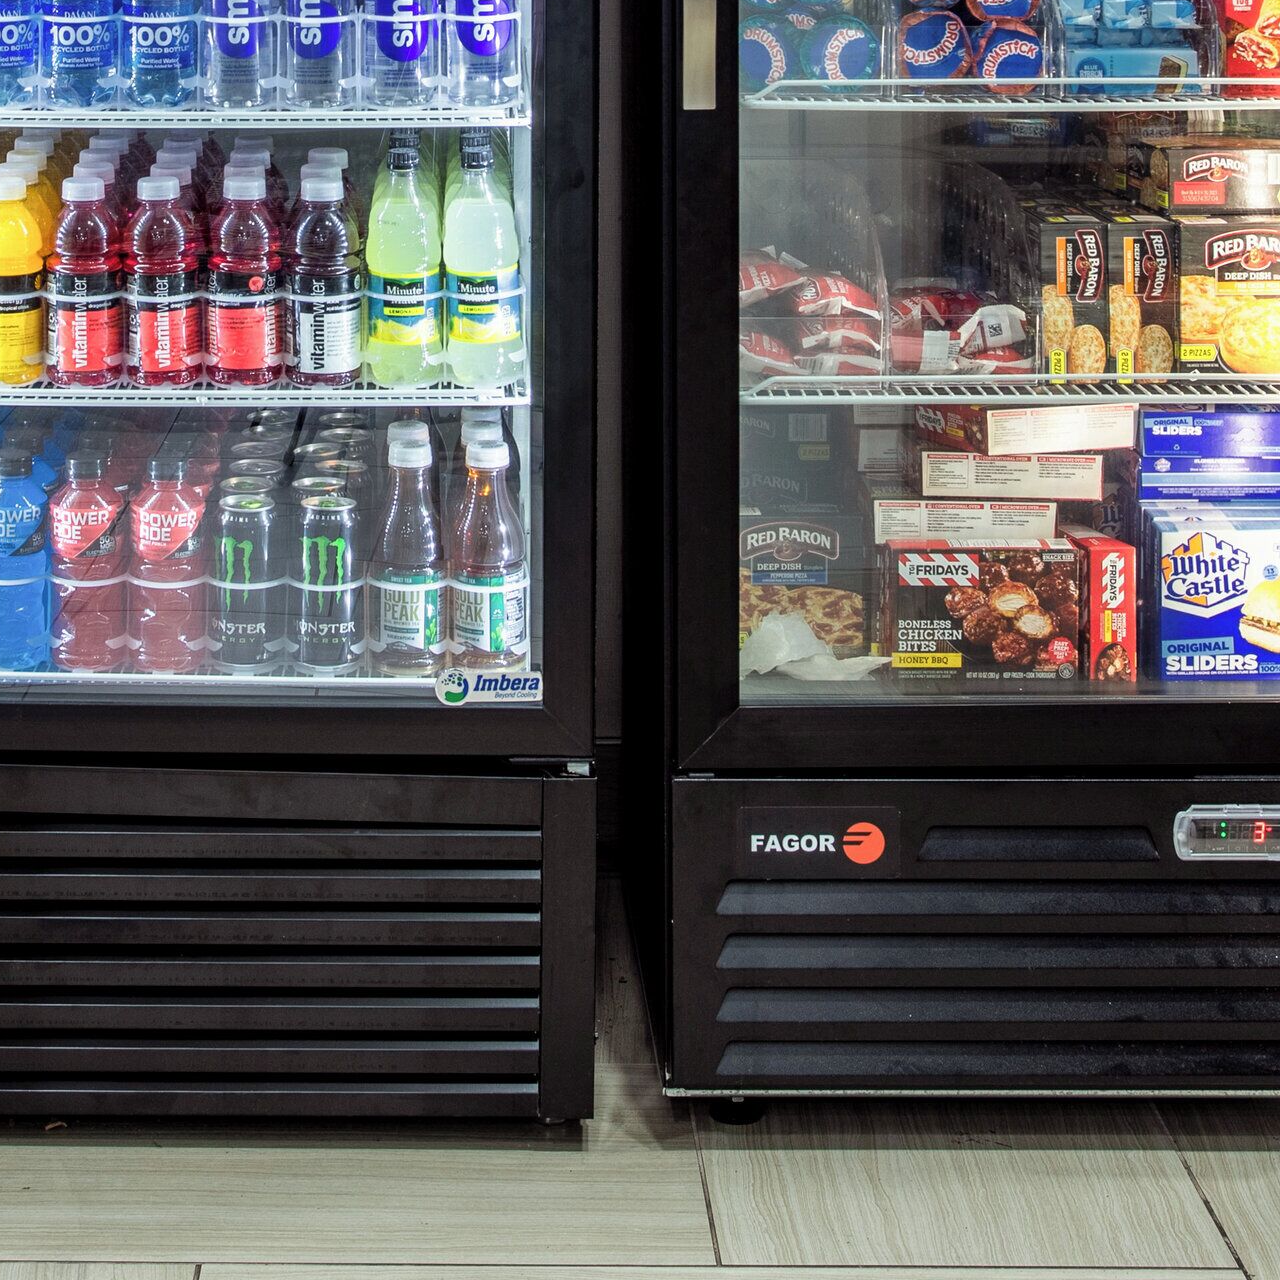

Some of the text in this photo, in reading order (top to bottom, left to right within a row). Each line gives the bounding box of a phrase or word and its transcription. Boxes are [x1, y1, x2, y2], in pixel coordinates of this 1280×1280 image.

[50, 23, 110, 45] 100%
[129, 24, 190, 46] 100%
[983, 40, 1038, 79] RUMSTICK
[1188, 156, 1249, 175] RED BARON
[1212, 237, 1244, 259] RED
[1082, 234, 1100, 297] RED BARON
[1150, 234, 1168, 297] RED BARON
[1224, 272, 1272, 280] DEEP DISH
[386, 285, 424, 296] Minute
[460, 285, 496, 294] Minute
[1183, 349, 1212, 357] 2 PIZZAS
[1152, 425, 1203, 436] SLIDERS
[1153, 418, 1189, 426] ORIGINAL
[53, 507, 110, 526] POWER
[140, 511, 197, 529] POWER
[53, 522, 82, 540] ADE
[140, 525, 171, 542] ADE
[747, 527, 831, 550] RED BARON
[757, 563, 802, 571] DEEP DISH
[908, 564, 969, 576] TGI FRIDAYS
[1170, 552, 1241, 581] White
[1109, 564, 1117, 602] FRIDAYS
[1165, 577, 1248, 601] Castle
[384, 588, 420, 604] GOLD
[384, 602, 419, 621] PEAK
[455, 602, 483, 622] PEAK
[211, 618, 266, 635] ONSTER
[898, 619, 952, 629] BONELESS
[897, 629, 962, 640] CHICKEN
[898, 641, 937, 652] BITES
[1167, 641, 1229, 654] ORIGINAL
[899, 656, 949, 665] HONEY BBQ
[1166, 654, 1258, 671] SLIDERS
[473, 674, 540, 692] Imbera
[516, 691, 538, 699] Cooling
[1253, 821, 1266, 843] 3
[750, 833, 836, 853] FAGOR
